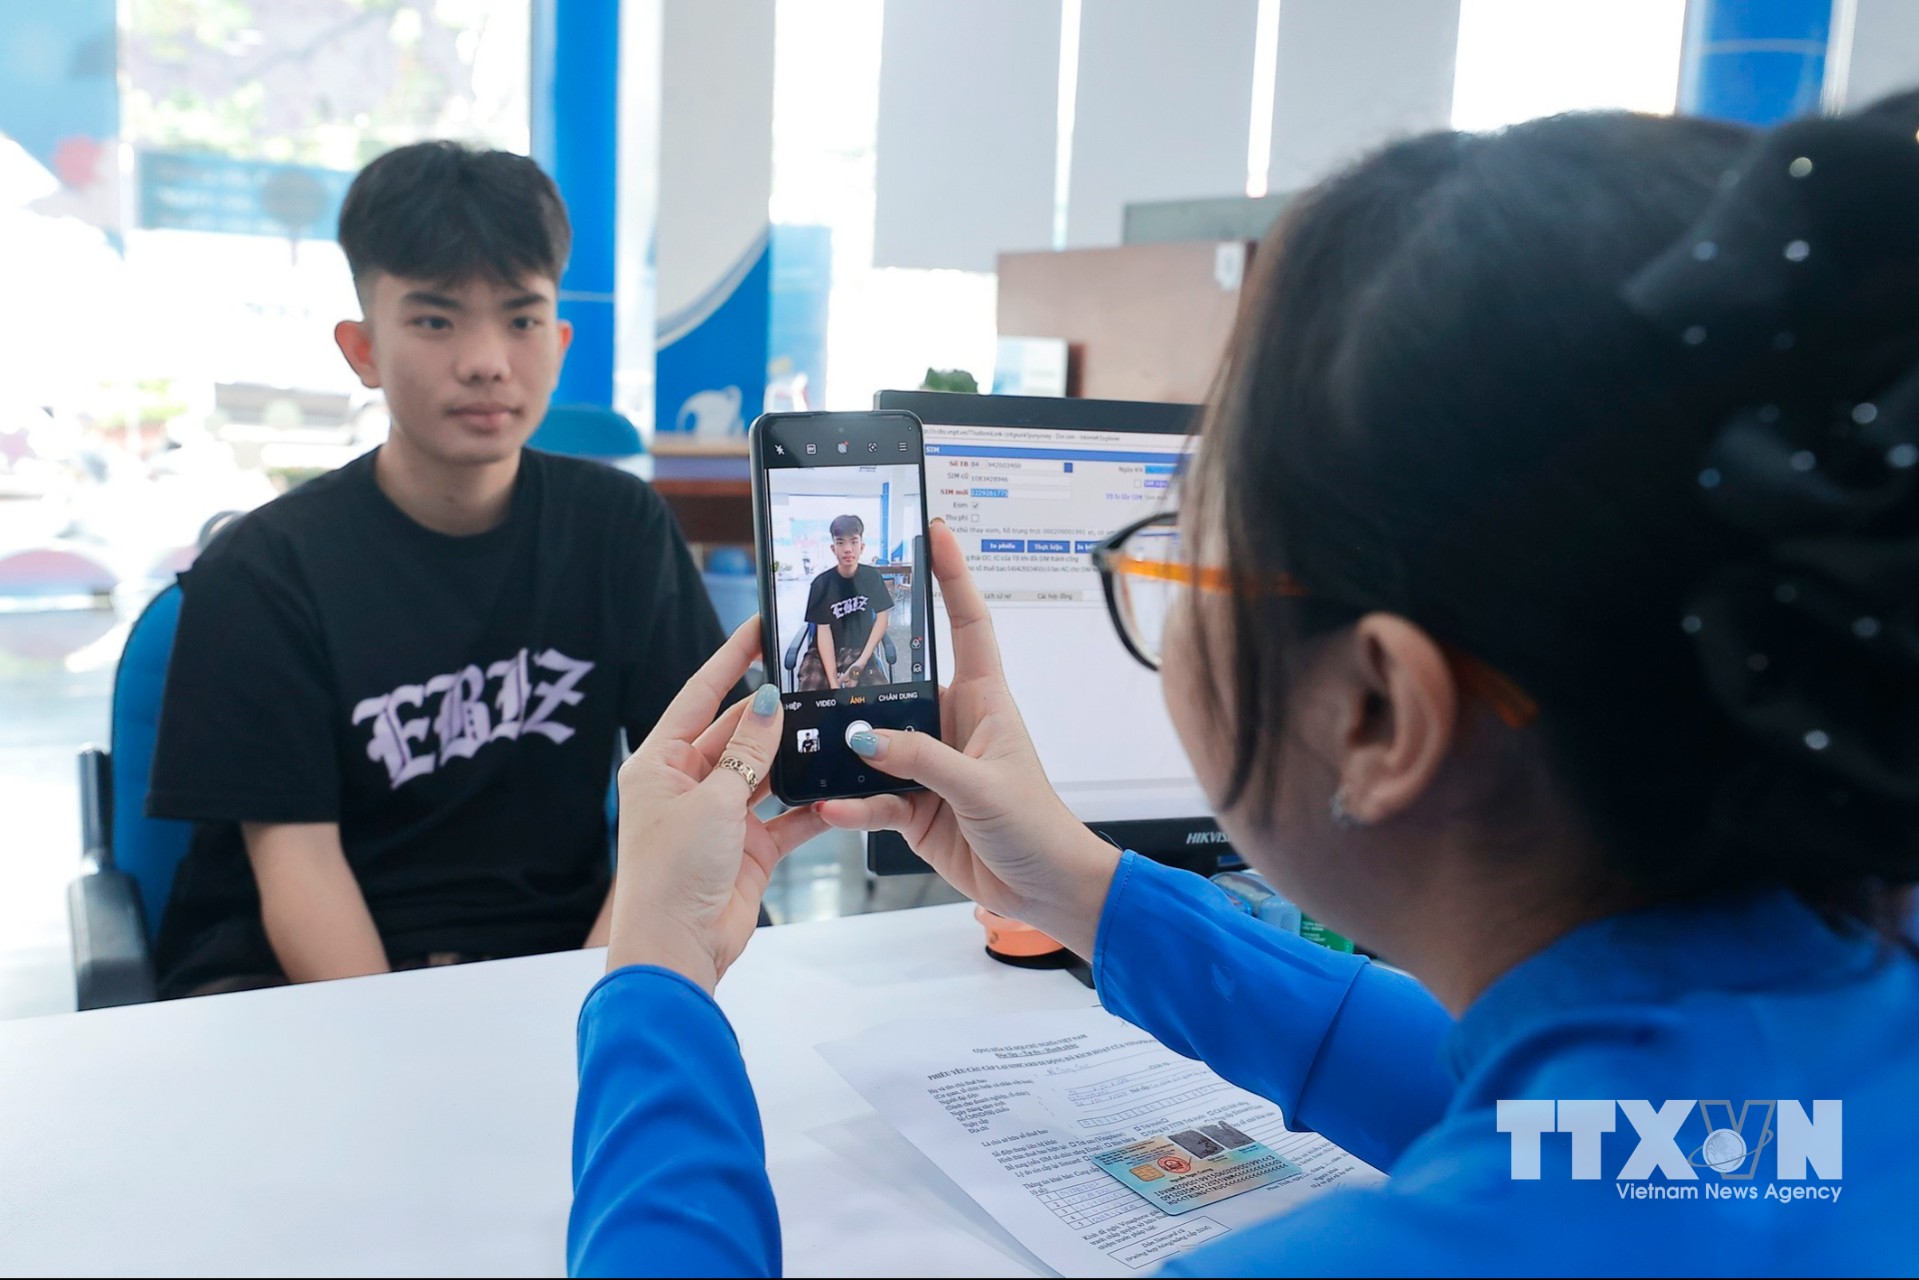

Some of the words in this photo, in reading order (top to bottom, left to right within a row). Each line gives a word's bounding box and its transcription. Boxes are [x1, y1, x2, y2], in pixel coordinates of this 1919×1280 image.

[850, 695, 865, 705] ẢNH
[878, 692, 898, 702] CHÂN
[899, 692, 918, 700] DUNG
[784, 702, 802, 711] HIỆP
[815, 699, 836, 708] VIDEO
[352, 648, 595, 789] EBIZ
[1186, 831, 1229, 844] HIKVIS
